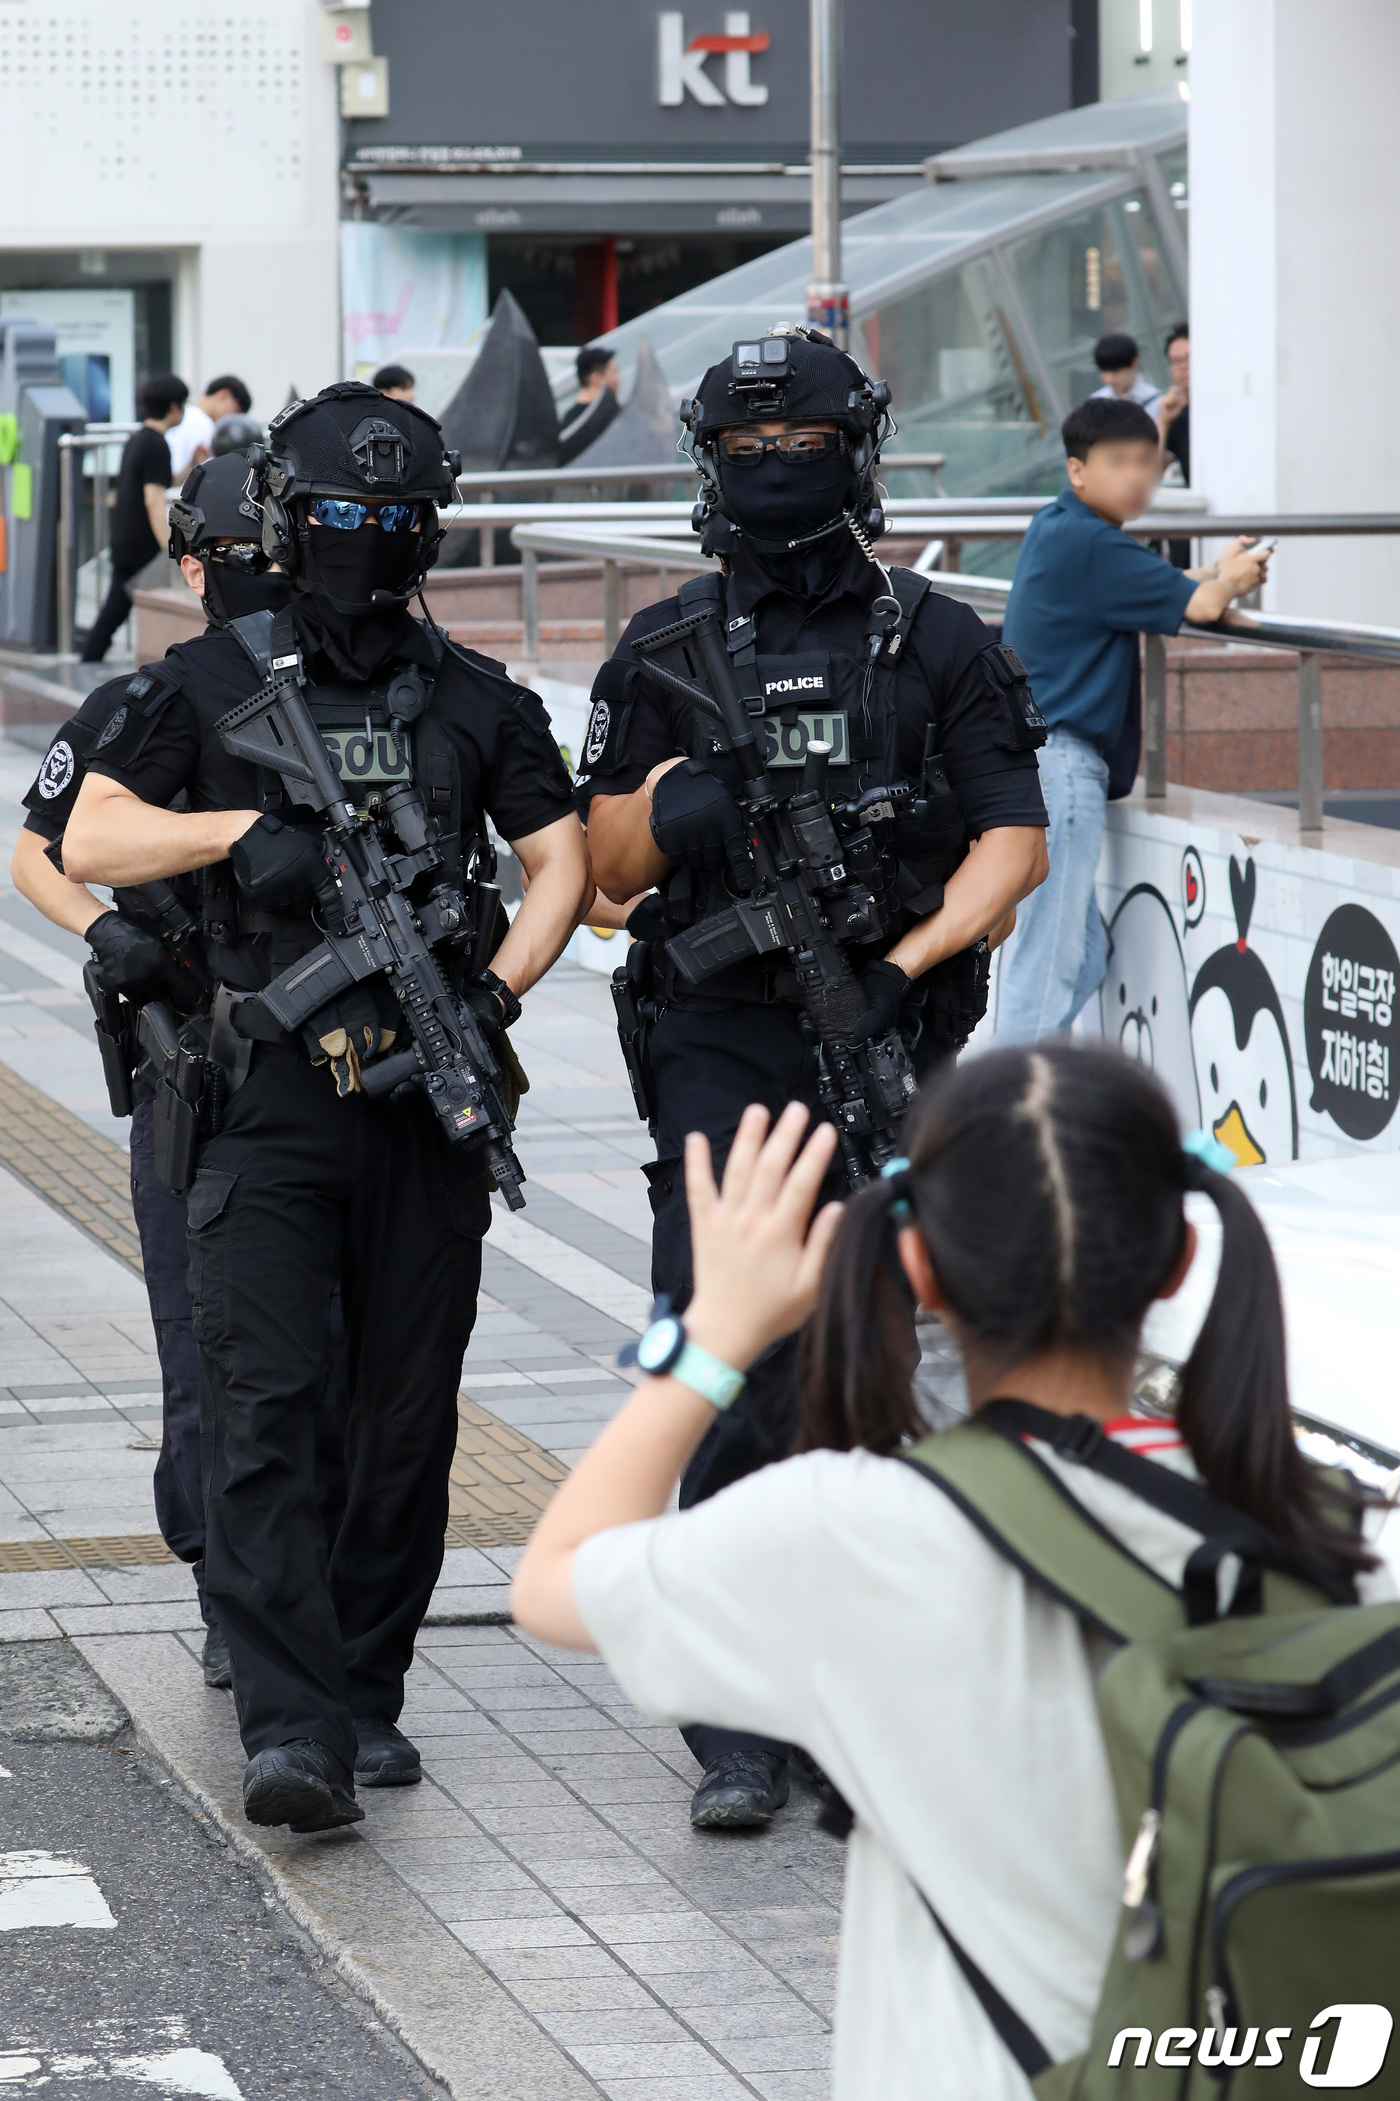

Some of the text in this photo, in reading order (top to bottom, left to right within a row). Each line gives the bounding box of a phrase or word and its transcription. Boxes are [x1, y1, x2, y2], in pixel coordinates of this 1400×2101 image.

[659, 11, 770, 106] kt
[765, 676, 824, 695] POLICE
[1321, 951, 1396, 1027] 한일극장
[1320, 1028, 1390, 1101] 지하1층!
